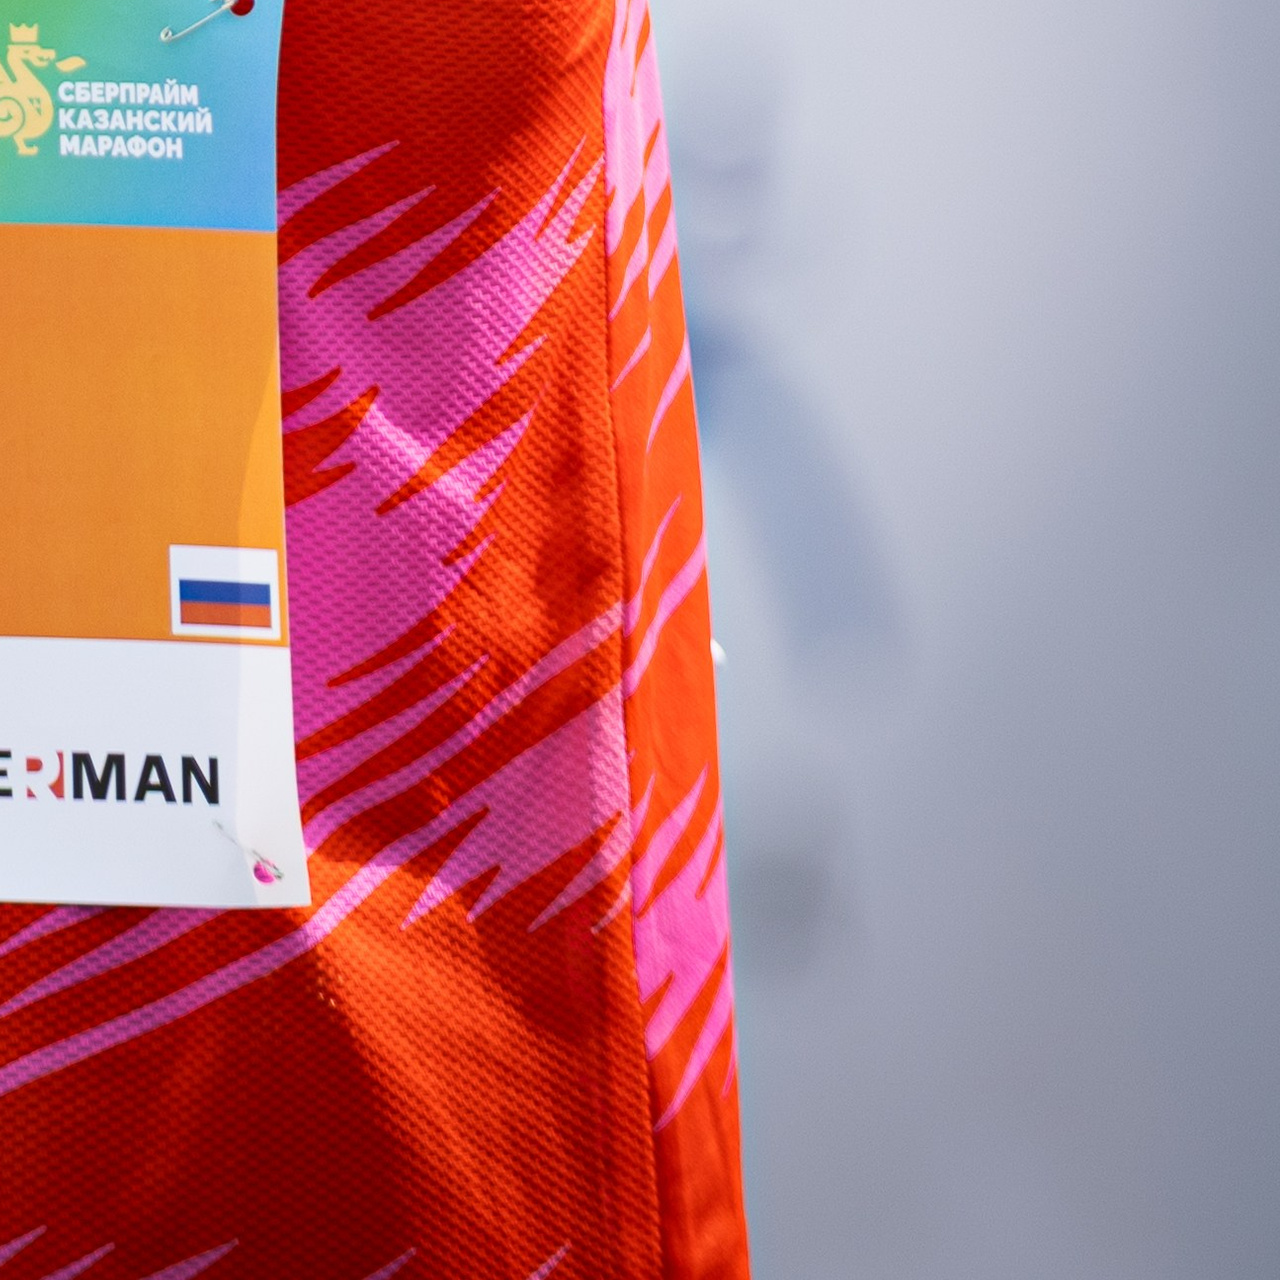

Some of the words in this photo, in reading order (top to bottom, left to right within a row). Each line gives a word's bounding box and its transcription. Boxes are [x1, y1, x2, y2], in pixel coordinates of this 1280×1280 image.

[58, 78, 198, 105] СБЕРПРАЙМ
[58, 107, 212, 133] КАЗАНСКИЙ
[60, 135, 183, 158] МАРАФОН
